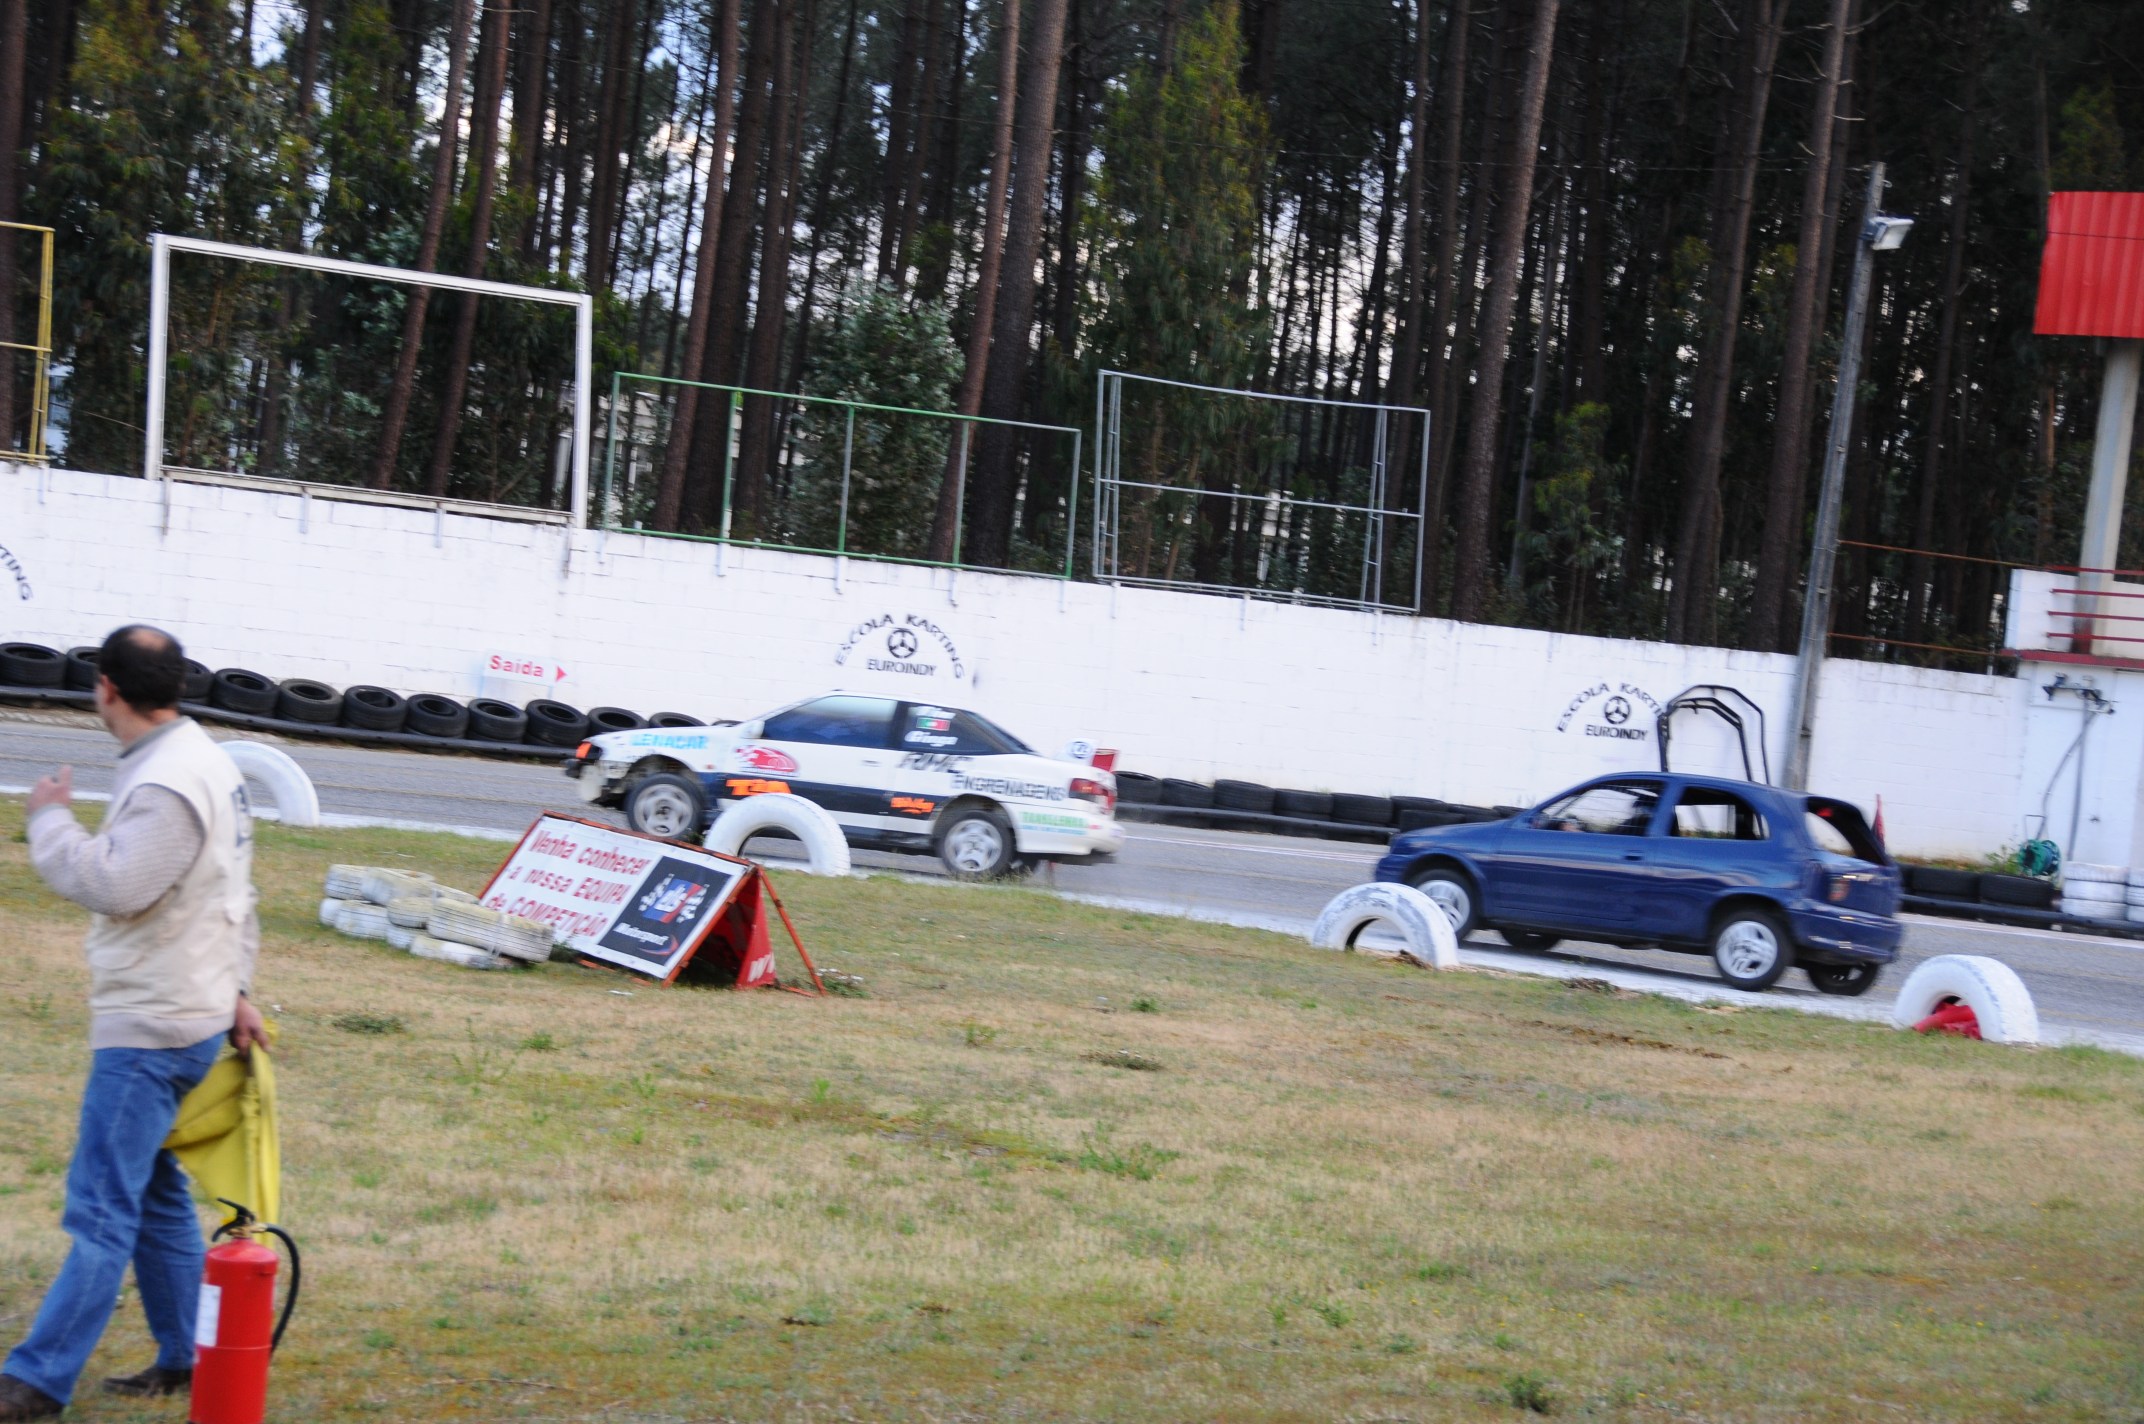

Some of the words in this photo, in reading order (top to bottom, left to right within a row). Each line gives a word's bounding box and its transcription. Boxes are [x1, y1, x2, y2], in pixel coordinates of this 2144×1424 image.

[0, 544, 34, 600] TING
[835, 613, 894, 666] ESCOLA
[905, 613, 965, 679] KARTING
[867, 659, 937, 676] EUROINDY
[1556, 682, 1611, 733] ESCOLA
[1585, 724, 1648, 741] EUROINDY
[529, 830, 578, 860] Venha
[577, 846, 653, 876] conhecer
[485, 893, 507, 912] de
[508, 866, 523, 880] a
[523, 868, 575, 893] nossa
[572, 877, 632, 905] EQUIPA
